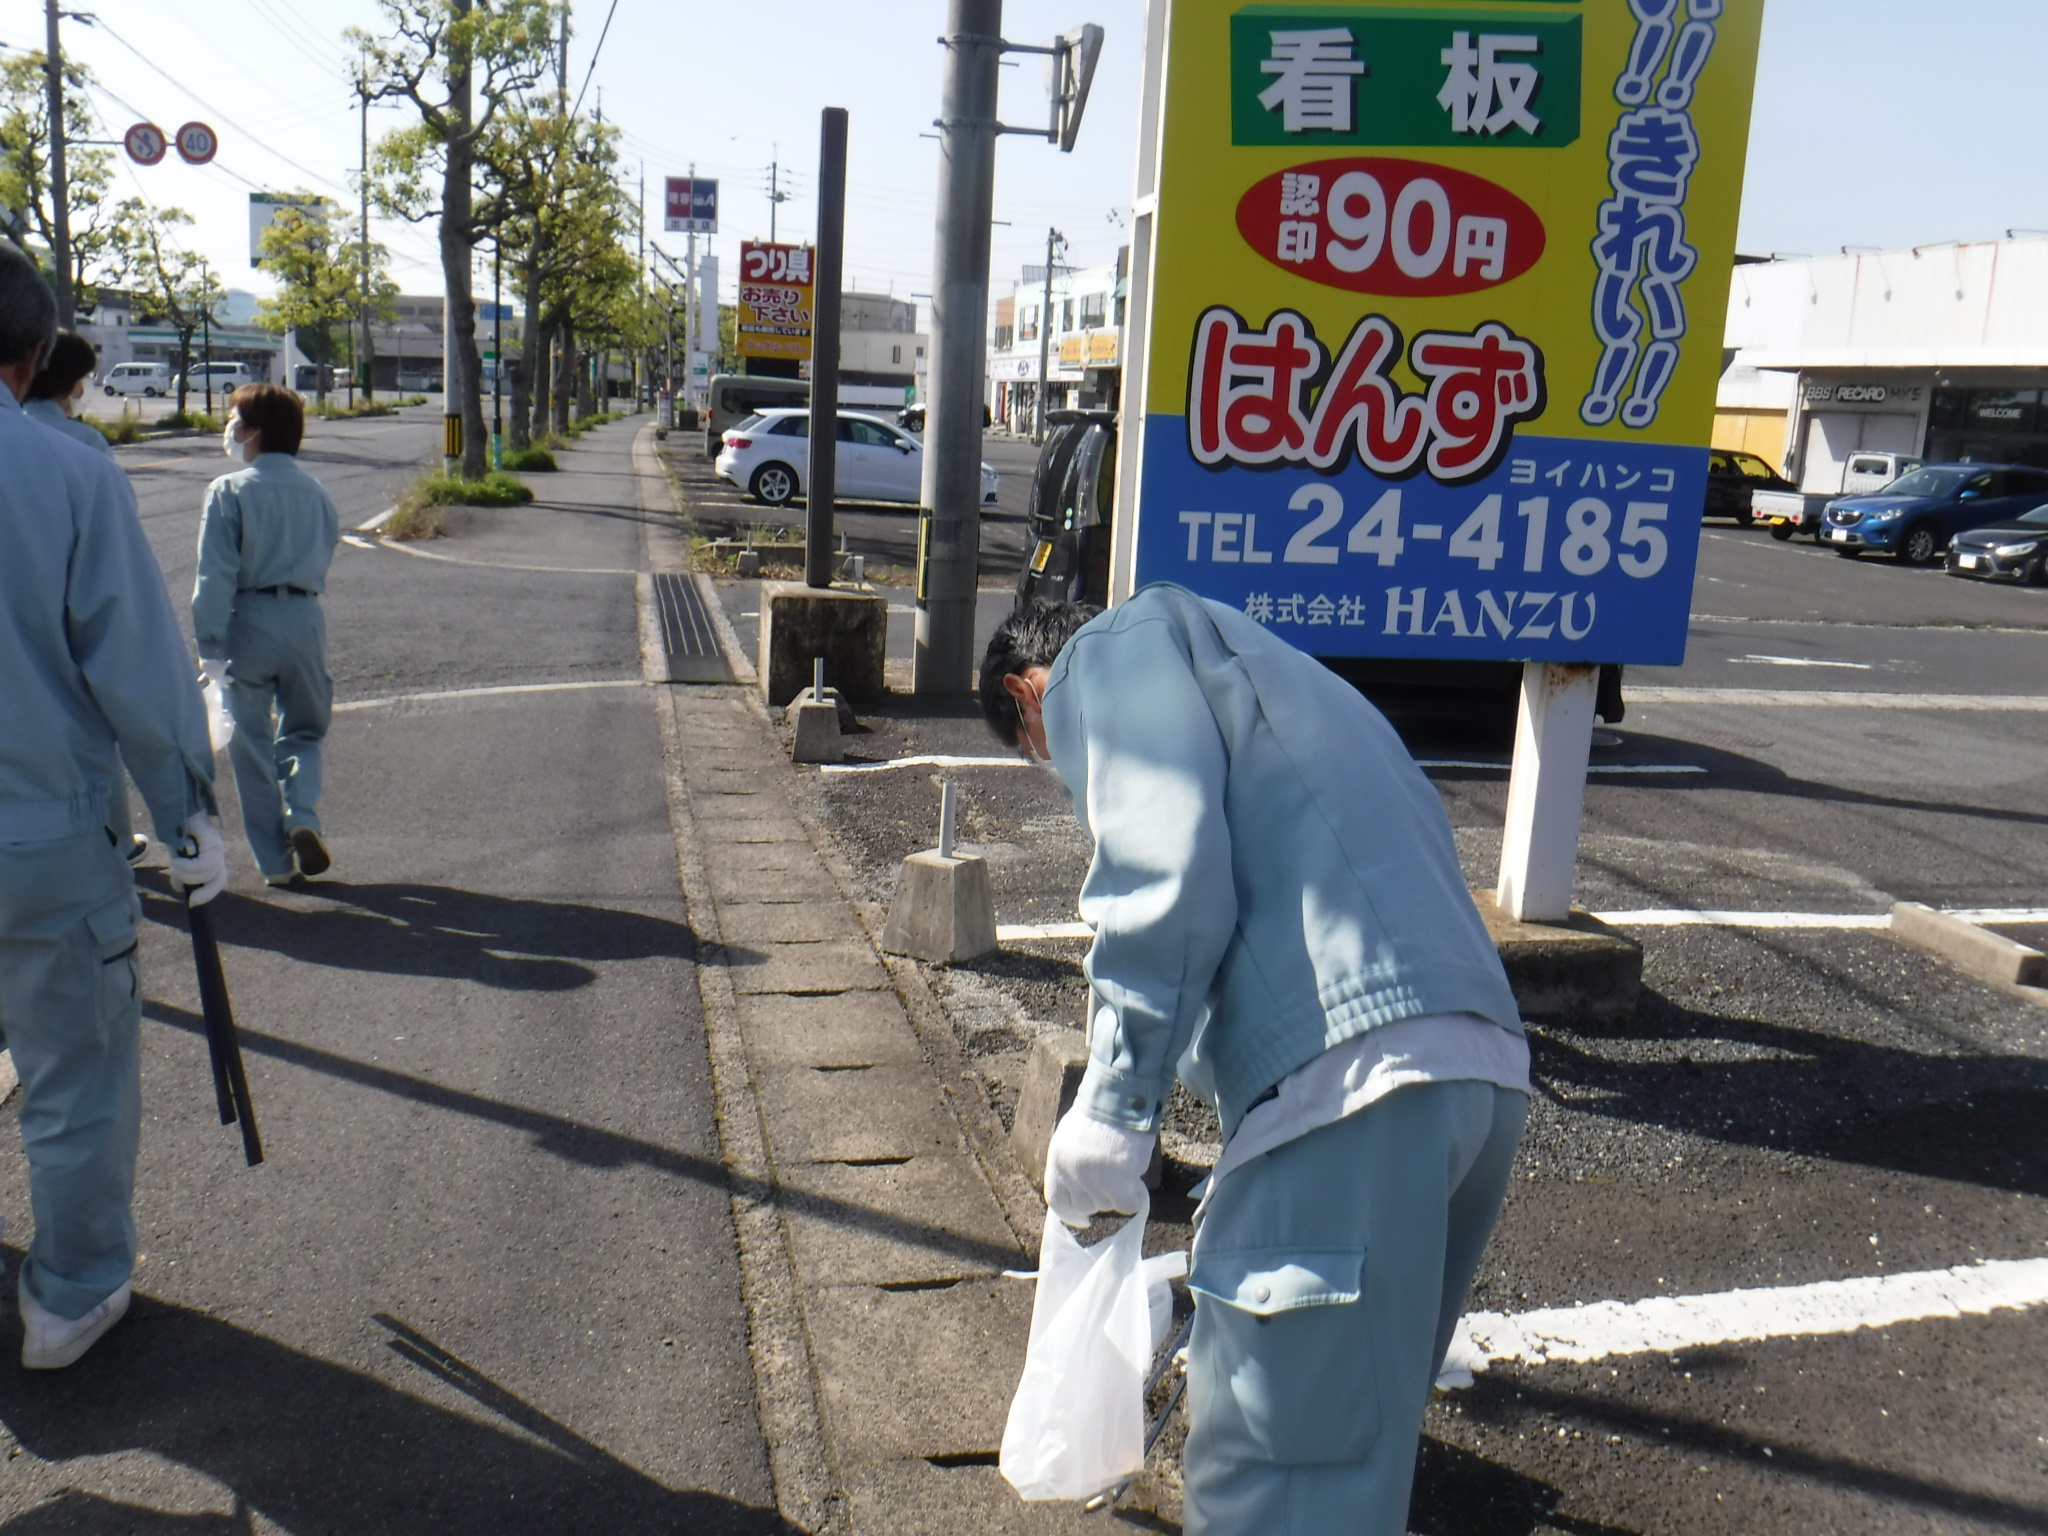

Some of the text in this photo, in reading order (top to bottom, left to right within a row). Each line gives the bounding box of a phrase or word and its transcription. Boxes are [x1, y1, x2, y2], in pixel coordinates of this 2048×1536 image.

[1257, 28, 1541, 135] 看板
[185, 133, 208, 153] 40
[1277, 171, 1508, 281] 認印 90円
[1581, 0, 1722, 428] !!きれい!!
[745, 249, 810, 283] つり具
[741, 285, 801, 305] お売り
[750, 304, 811, 324] 下さい
[1188, 307, 1543, 483] はんず
[1806, 386, 1832, 400] BBS
[1837, 386, 1885, 401] RECARO
[1979, 408, 2022, 419] WELCOME
[1510, 459, 1675, 492] ヨイハンコ
[1179, 482, 1668, 578] TEL 24-4185
[1243, 586, 1596, 641] 株式会社 HANZU
